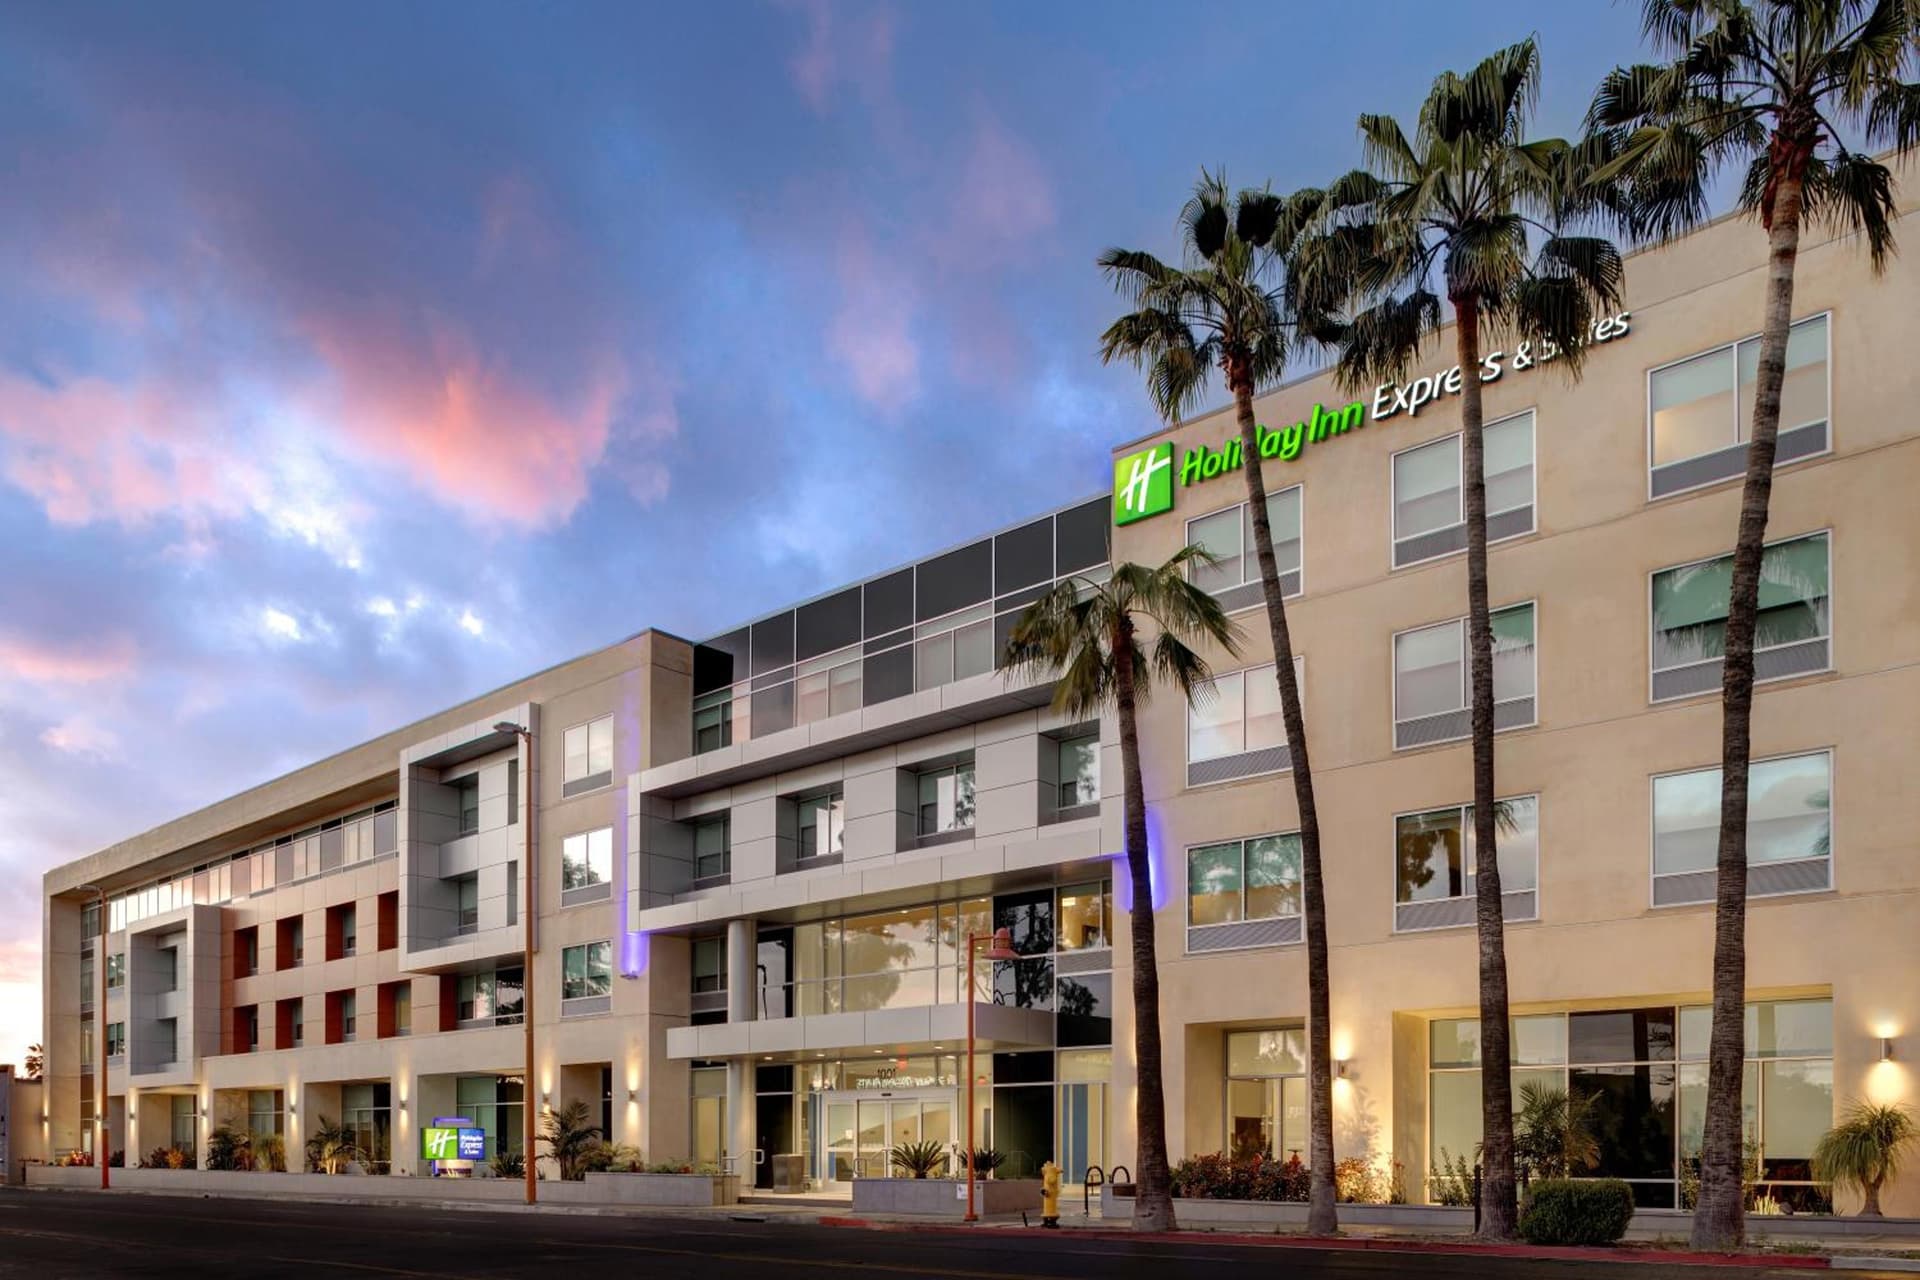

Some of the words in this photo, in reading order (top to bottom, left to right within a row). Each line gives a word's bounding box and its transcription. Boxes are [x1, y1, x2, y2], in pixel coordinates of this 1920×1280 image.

[1308, 402, 1365, 443] Inn
[1371, 350, 1505, 420] Expres
[1511, 340, 1533, 371] &
